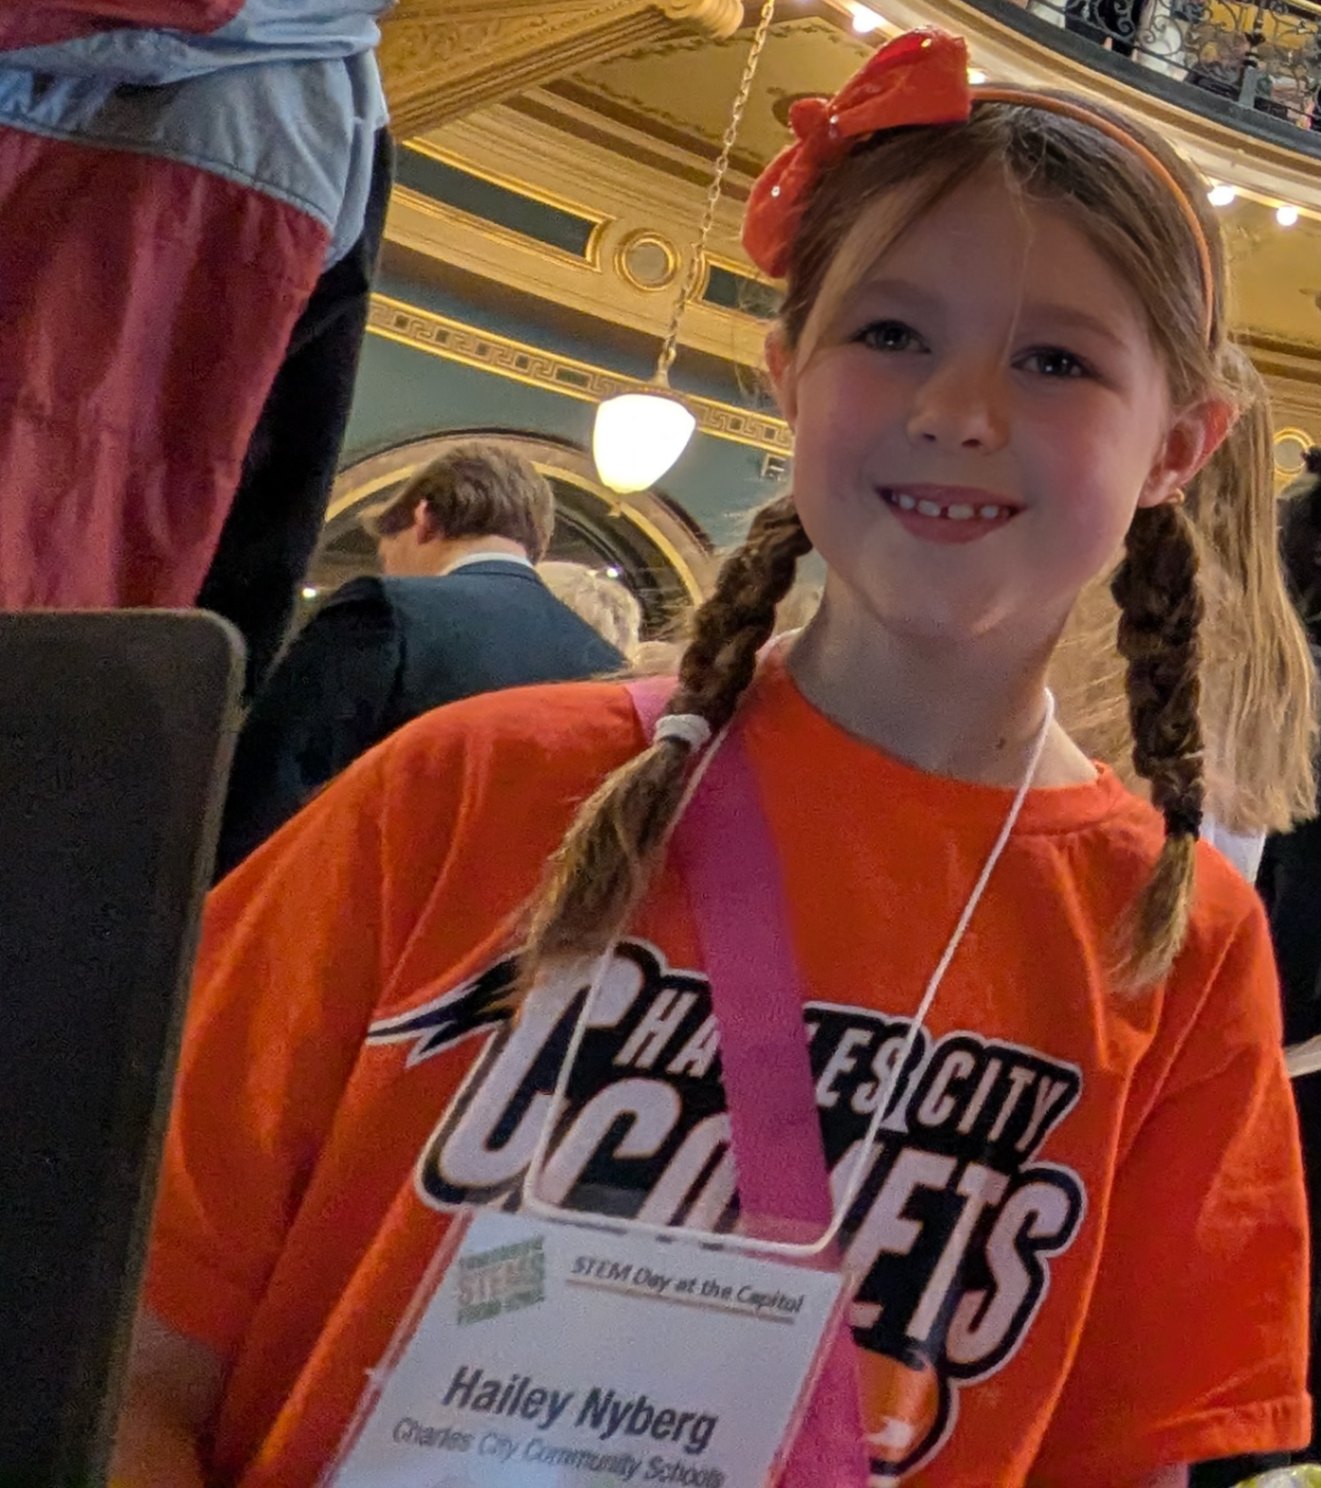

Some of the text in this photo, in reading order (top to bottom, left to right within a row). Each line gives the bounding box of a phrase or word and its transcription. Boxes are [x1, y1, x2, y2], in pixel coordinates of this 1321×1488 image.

[440, 946, 1062, 1188] CHAES CITY
[571, 1255, 805, 1313] STEM Day at the Capitol
[441, 1365, 719, 1455] Hailey Nyberg
